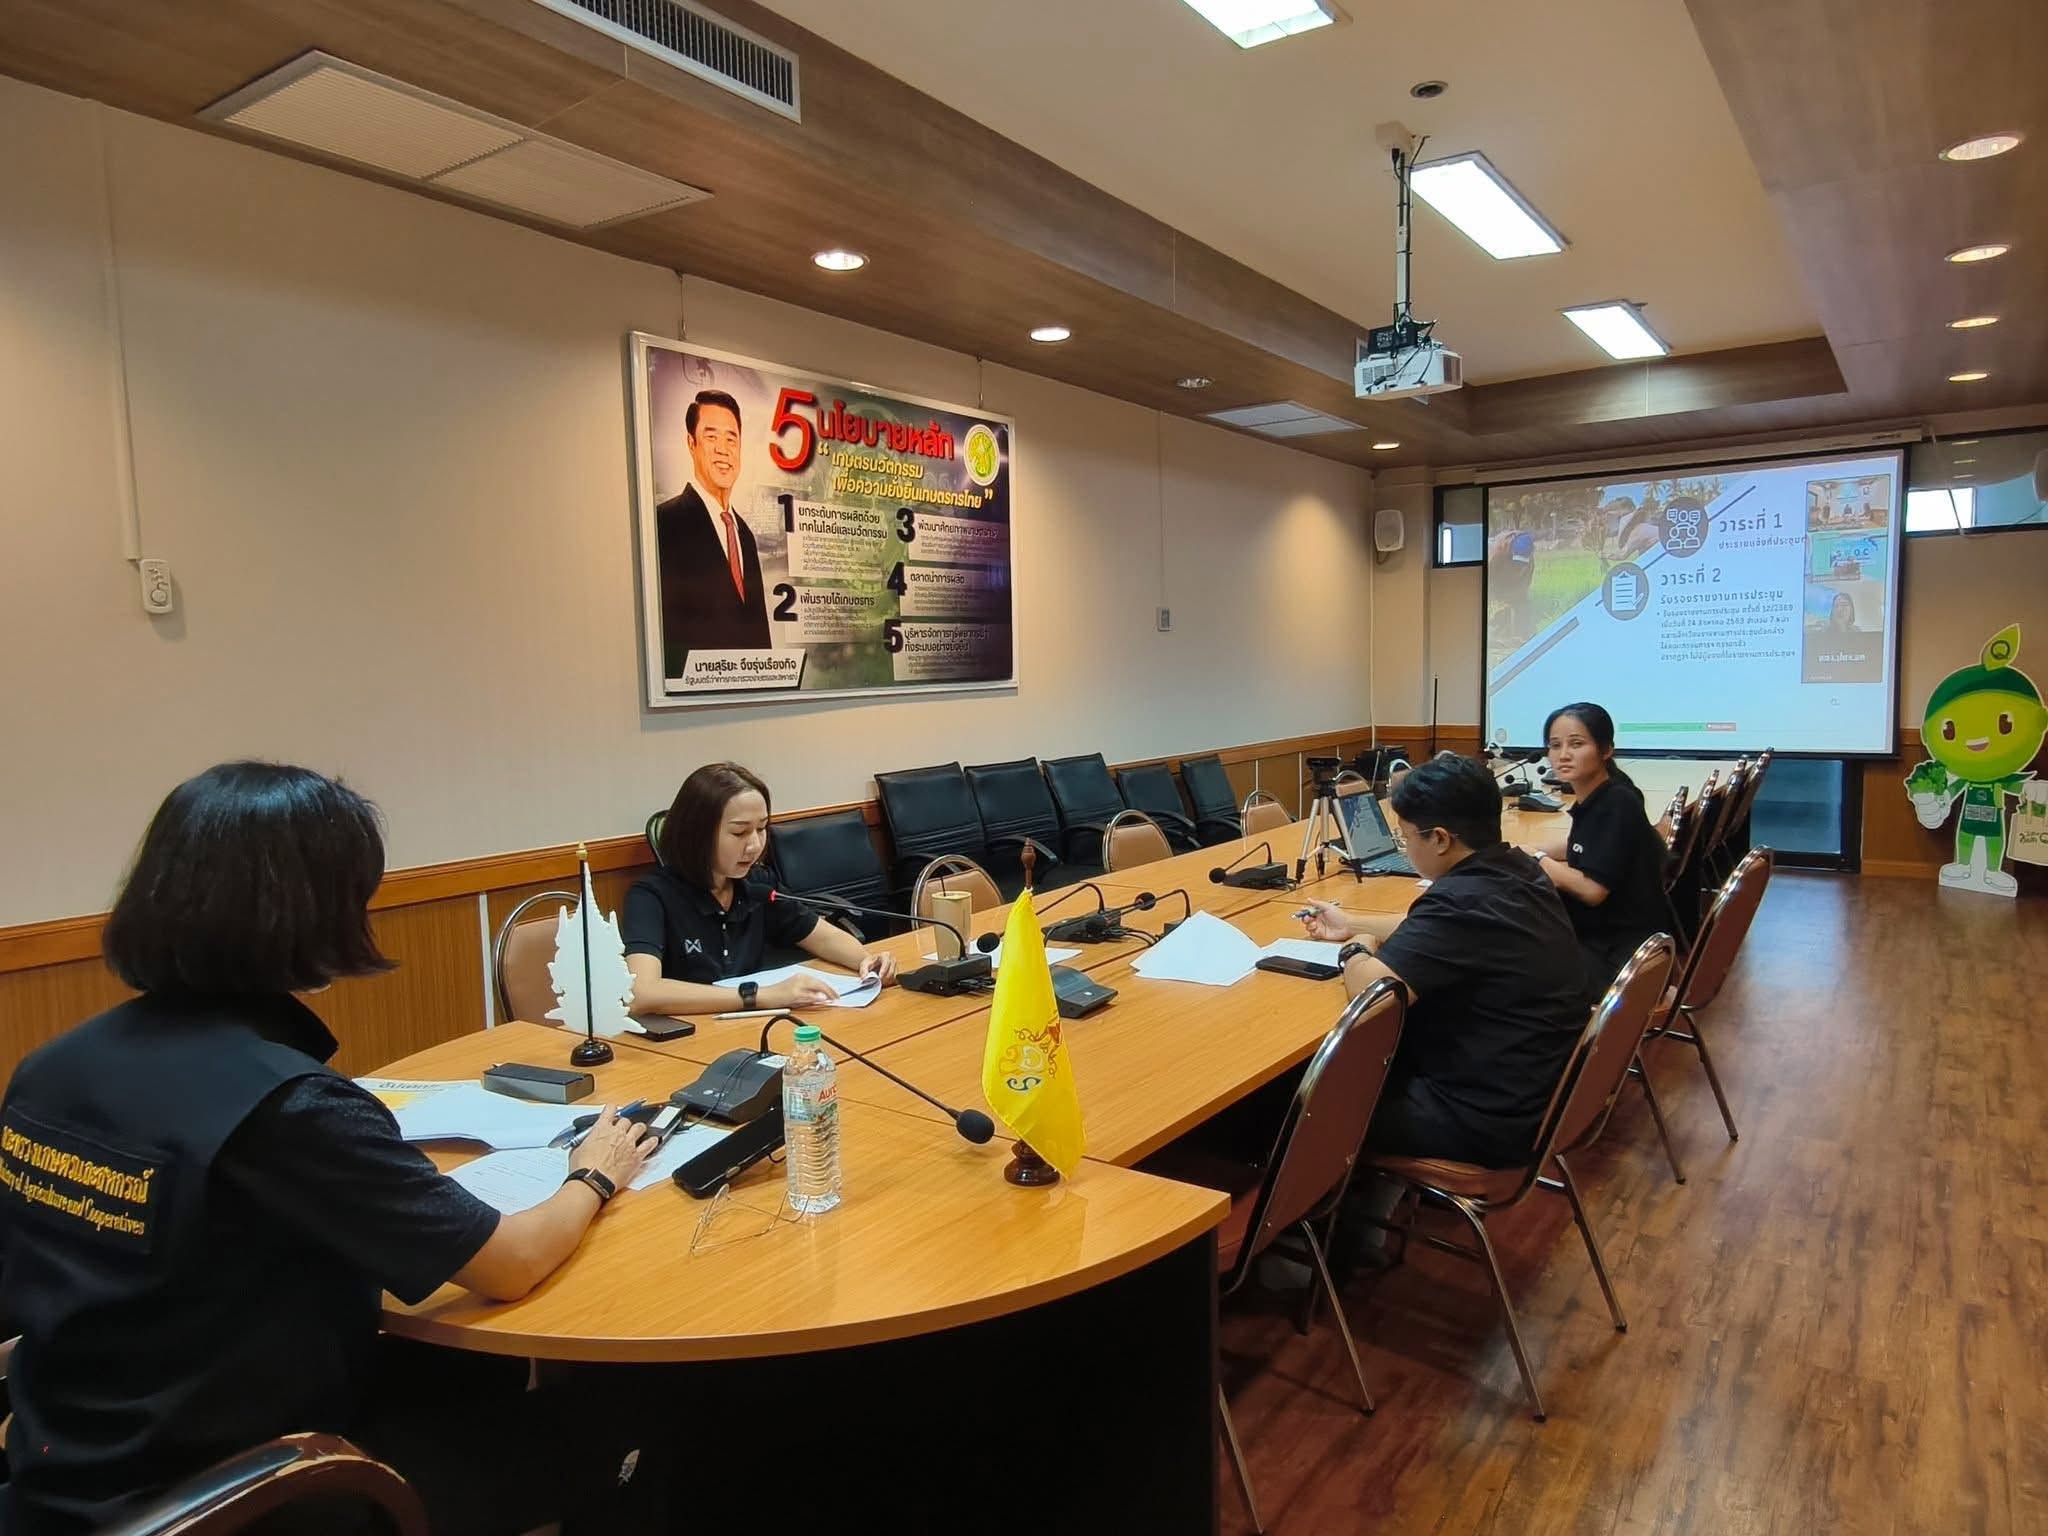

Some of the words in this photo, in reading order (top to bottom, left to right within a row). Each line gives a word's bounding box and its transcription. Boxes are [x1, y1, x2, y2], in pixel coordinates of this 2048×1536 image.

[769, 387, 816, 472] 5
[815, 401, 955, 460] นโยบายหลัก
[777, 494, 795, 532] 1
[798, 506, 881, 524] ยกระดับการผลิตด้วย
[799, 520, 888, 539] เทคโนโลยีและนวัตกรรม
[896, 507, 916, 543] 3
[1719, 508, 1766, 533] วาระที่
[1773, 513, 1783, 529] 1
[887, 562, 908, 597] 4
[1660, 564, 1705, 586] วาระที่
[1711, 568, 1721, 583] 2
[773, 583, 799, 622] 2
[884, 619, 904, 653] 5
[695, 659, 737, 676] นายสุริยะ
[740, 657, 797, 674] จึงรุ่งเรืองกิจ
